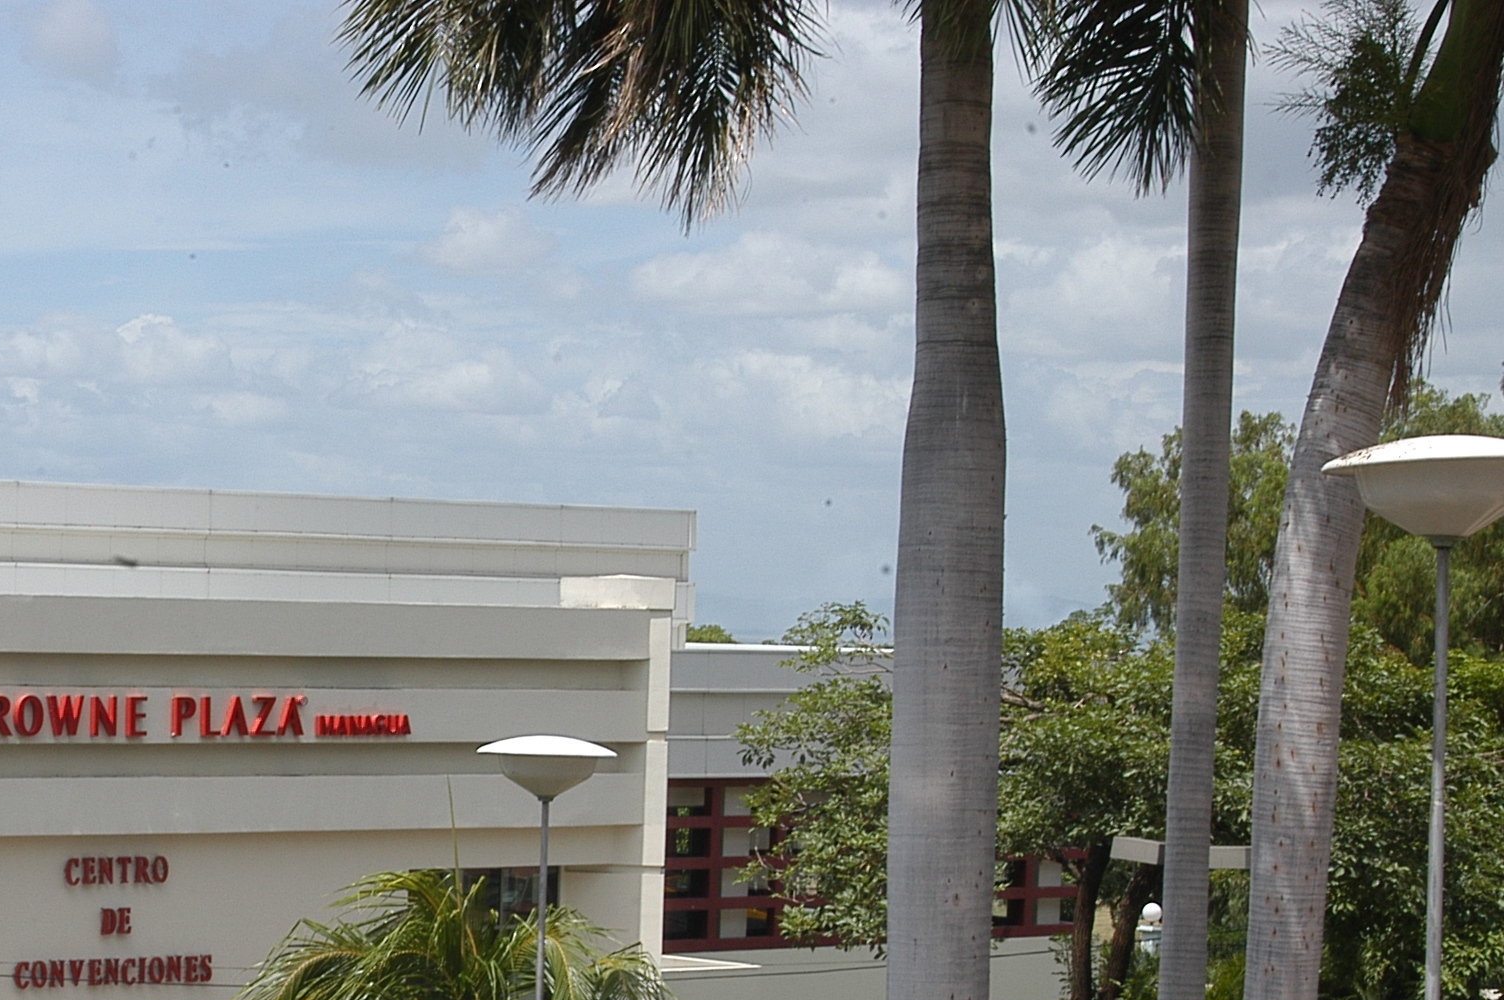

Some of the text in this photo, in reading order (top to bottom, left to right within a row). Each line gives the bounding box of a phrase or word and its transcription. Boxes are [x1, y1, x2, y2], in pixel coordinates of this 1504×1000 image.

[171, 695, 304, 737] PLAZA
[315, 714, 412, 737] MANAGUA
[64, 855, 169, 886] CENTRO
[100, 906, 132, 936] DE
[13, 954, 213, 990] CONVENCIONES
